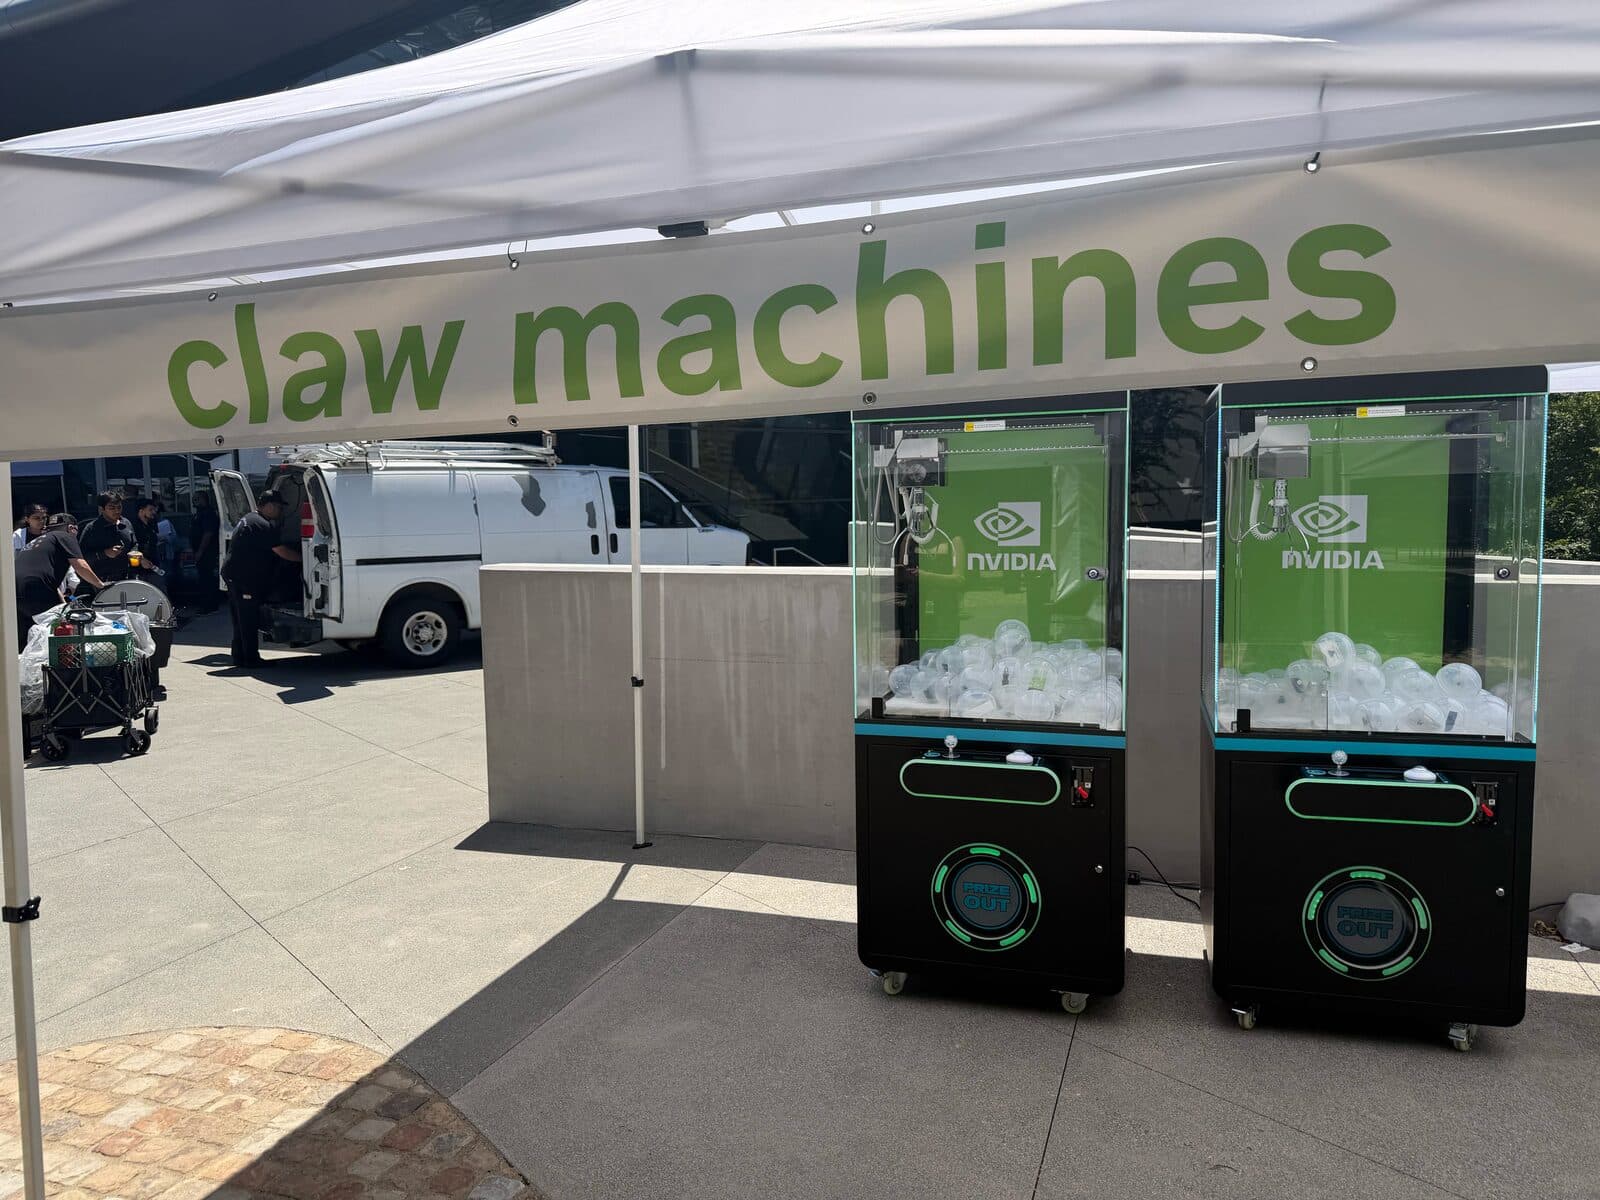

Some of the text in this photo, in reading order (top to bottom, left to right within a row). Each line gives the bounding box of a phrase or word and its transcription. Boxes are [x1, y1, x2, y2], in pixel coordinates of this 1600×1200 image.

[168, 222, 1397, 430] claw machines
[963, 882, 1010, 896] PRIZE
[963, 895, 1010, 912] OUT
[1337, 920, 1393, 939] OUT
